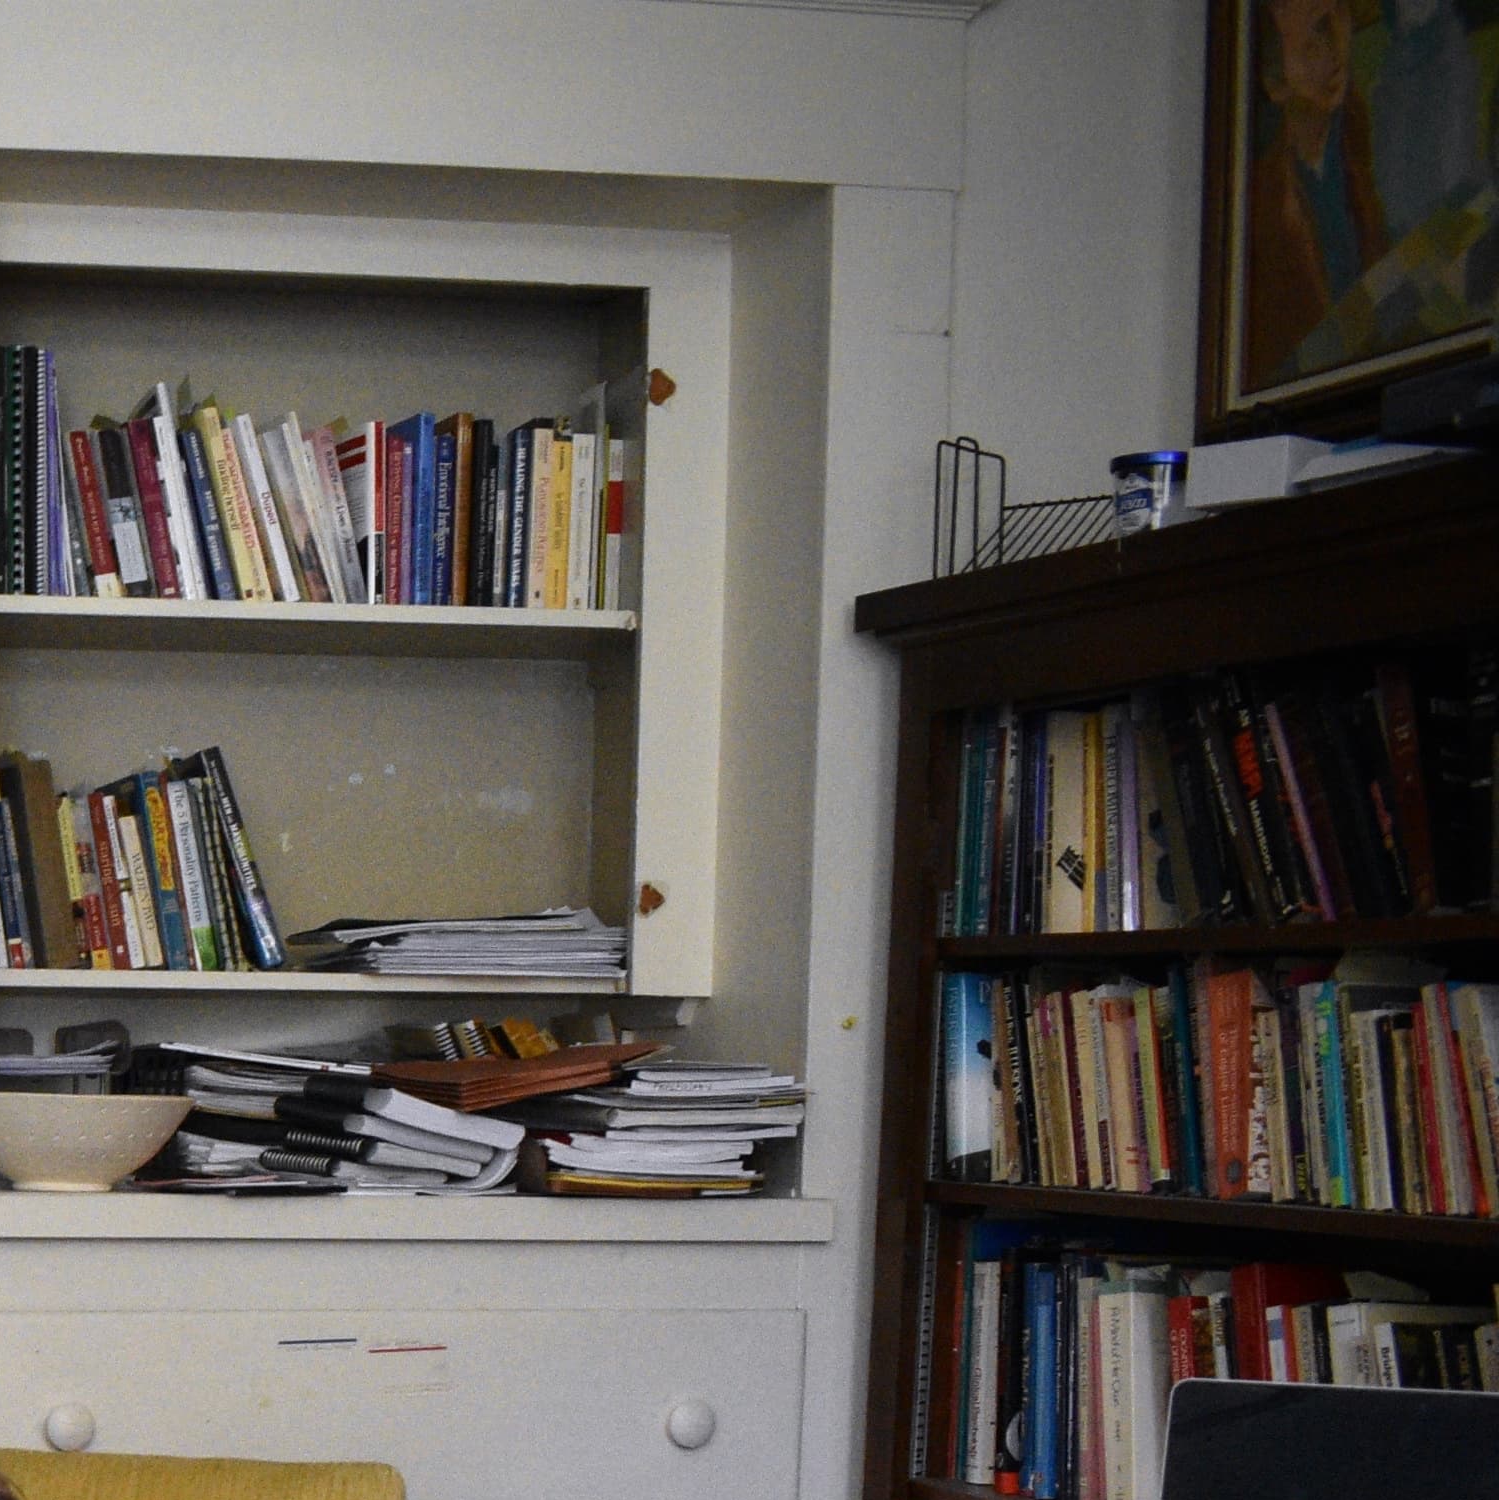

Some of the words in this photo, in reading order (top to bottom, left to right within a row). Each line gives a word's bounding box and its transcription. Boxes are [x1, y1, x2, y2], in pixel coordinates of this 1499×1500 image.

[436, 462, 453, 509] Emotional
[517, 447, 528, 492] HEALING
[260, 491, 278, 526] Duped
[515, 495, 526, 514] THE
[433, 511, 451, 559] Intelligence
[513, 518, 525, 555] GENDER
[512, 559, 524, 588] WARS
[173, 787, 188, 810] The
[177, 821, 196, 878] Personality
[185, 879, 204, 923] Patterns
